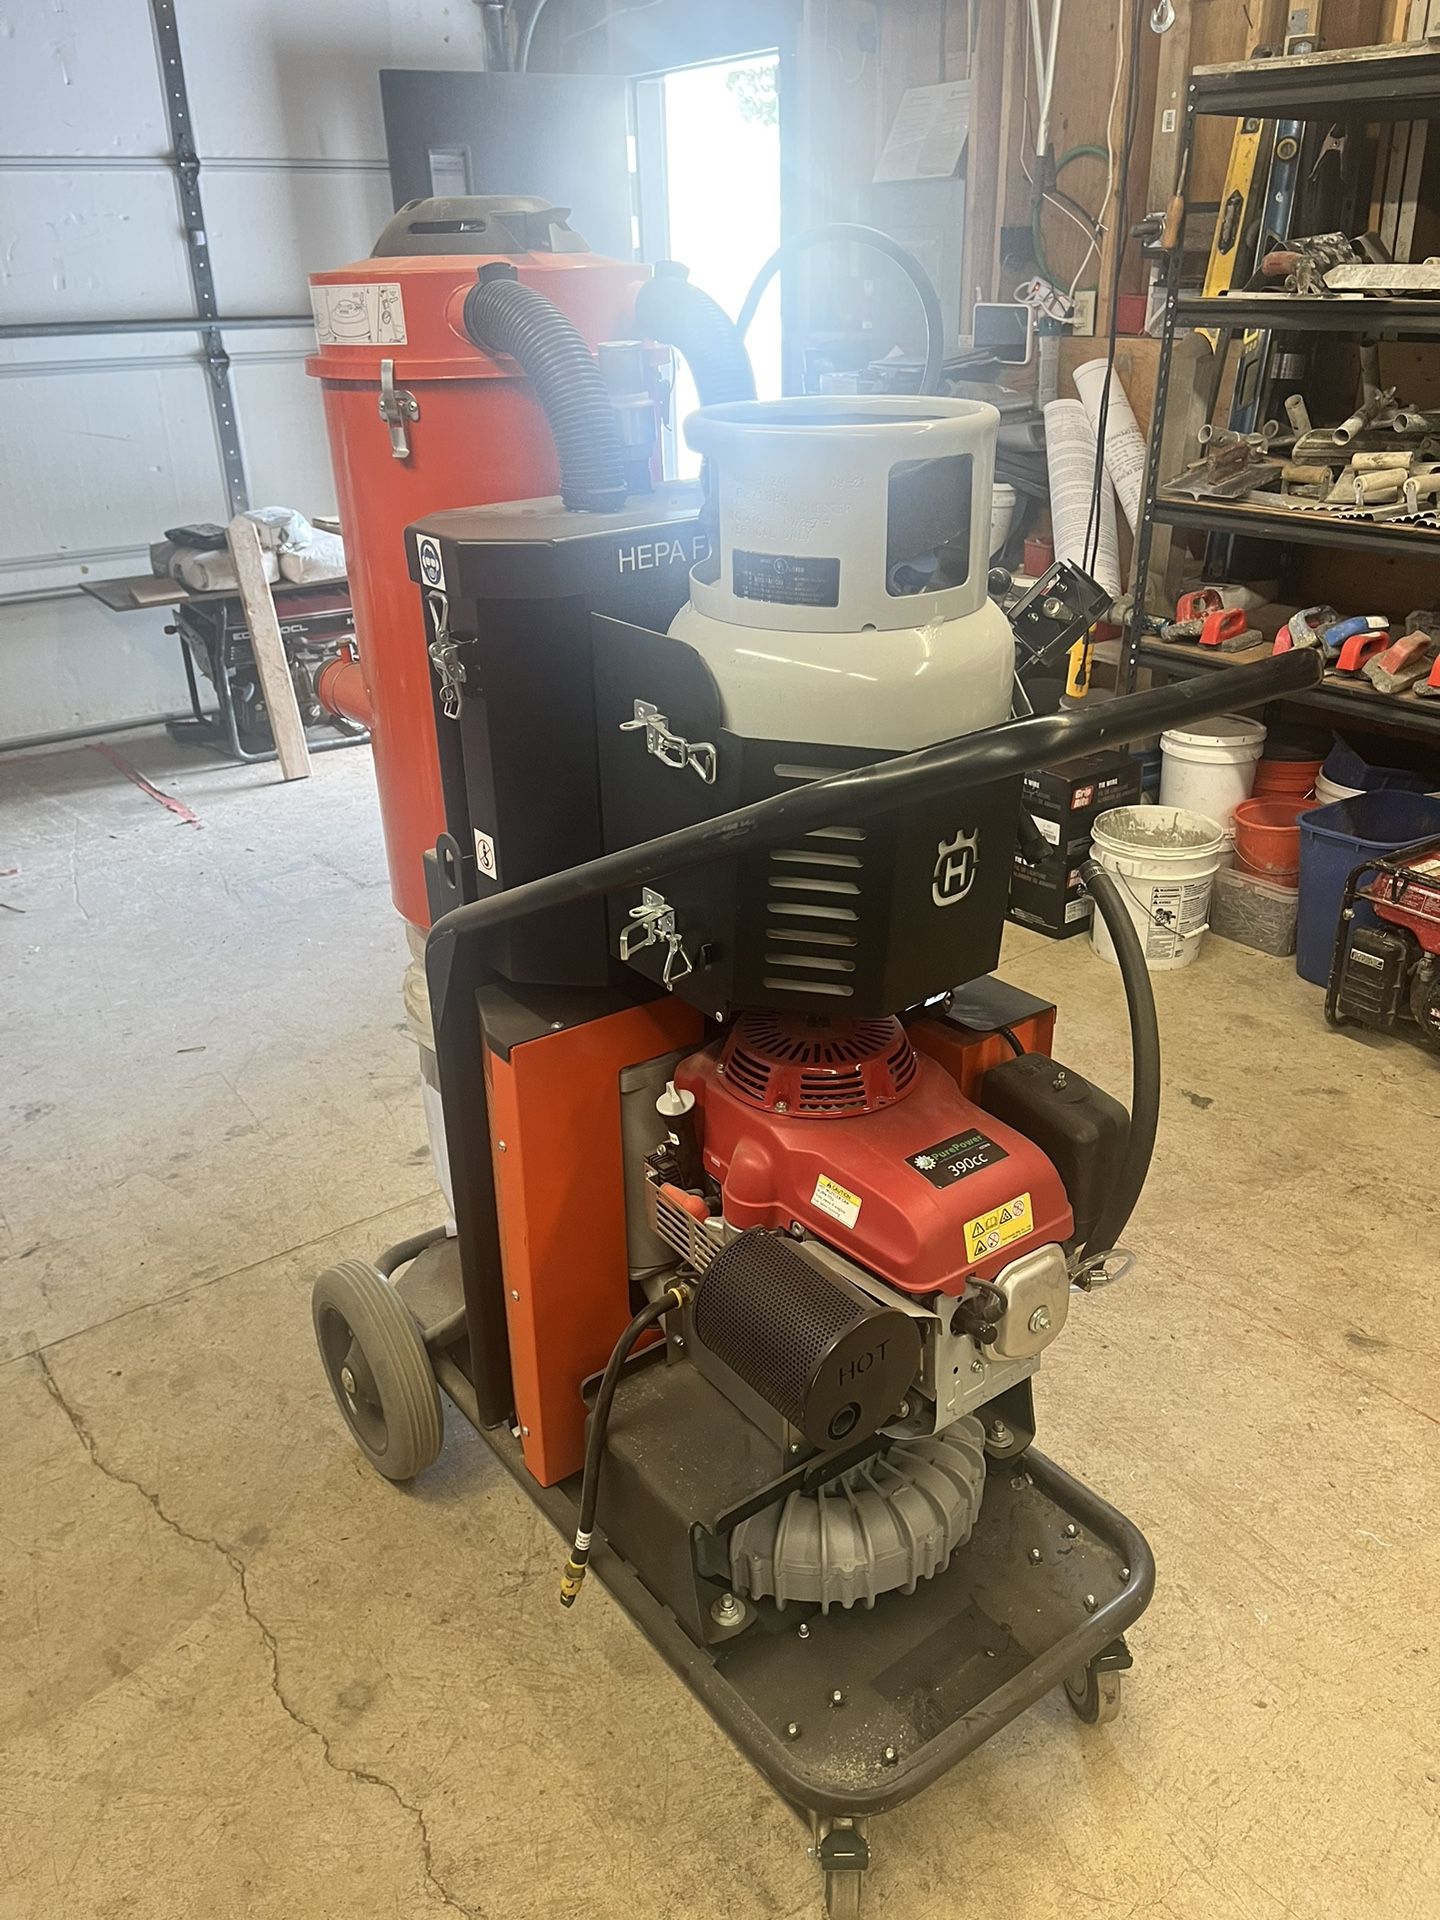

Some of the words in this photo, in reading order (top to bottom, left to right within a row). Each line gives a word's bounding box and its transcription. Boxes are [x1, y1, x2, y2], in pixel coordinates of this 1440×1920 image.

[618, 539, 686, 573] HEPA
[1075, 787, 1092, 799] Grip
[931, 1135, 983, 1161] PurePower
[947, 1153, 989, 1177] 390cc
[832, 1185, 851, 1200] CAUTION
[839, 1339, 890, 1387] HOT
